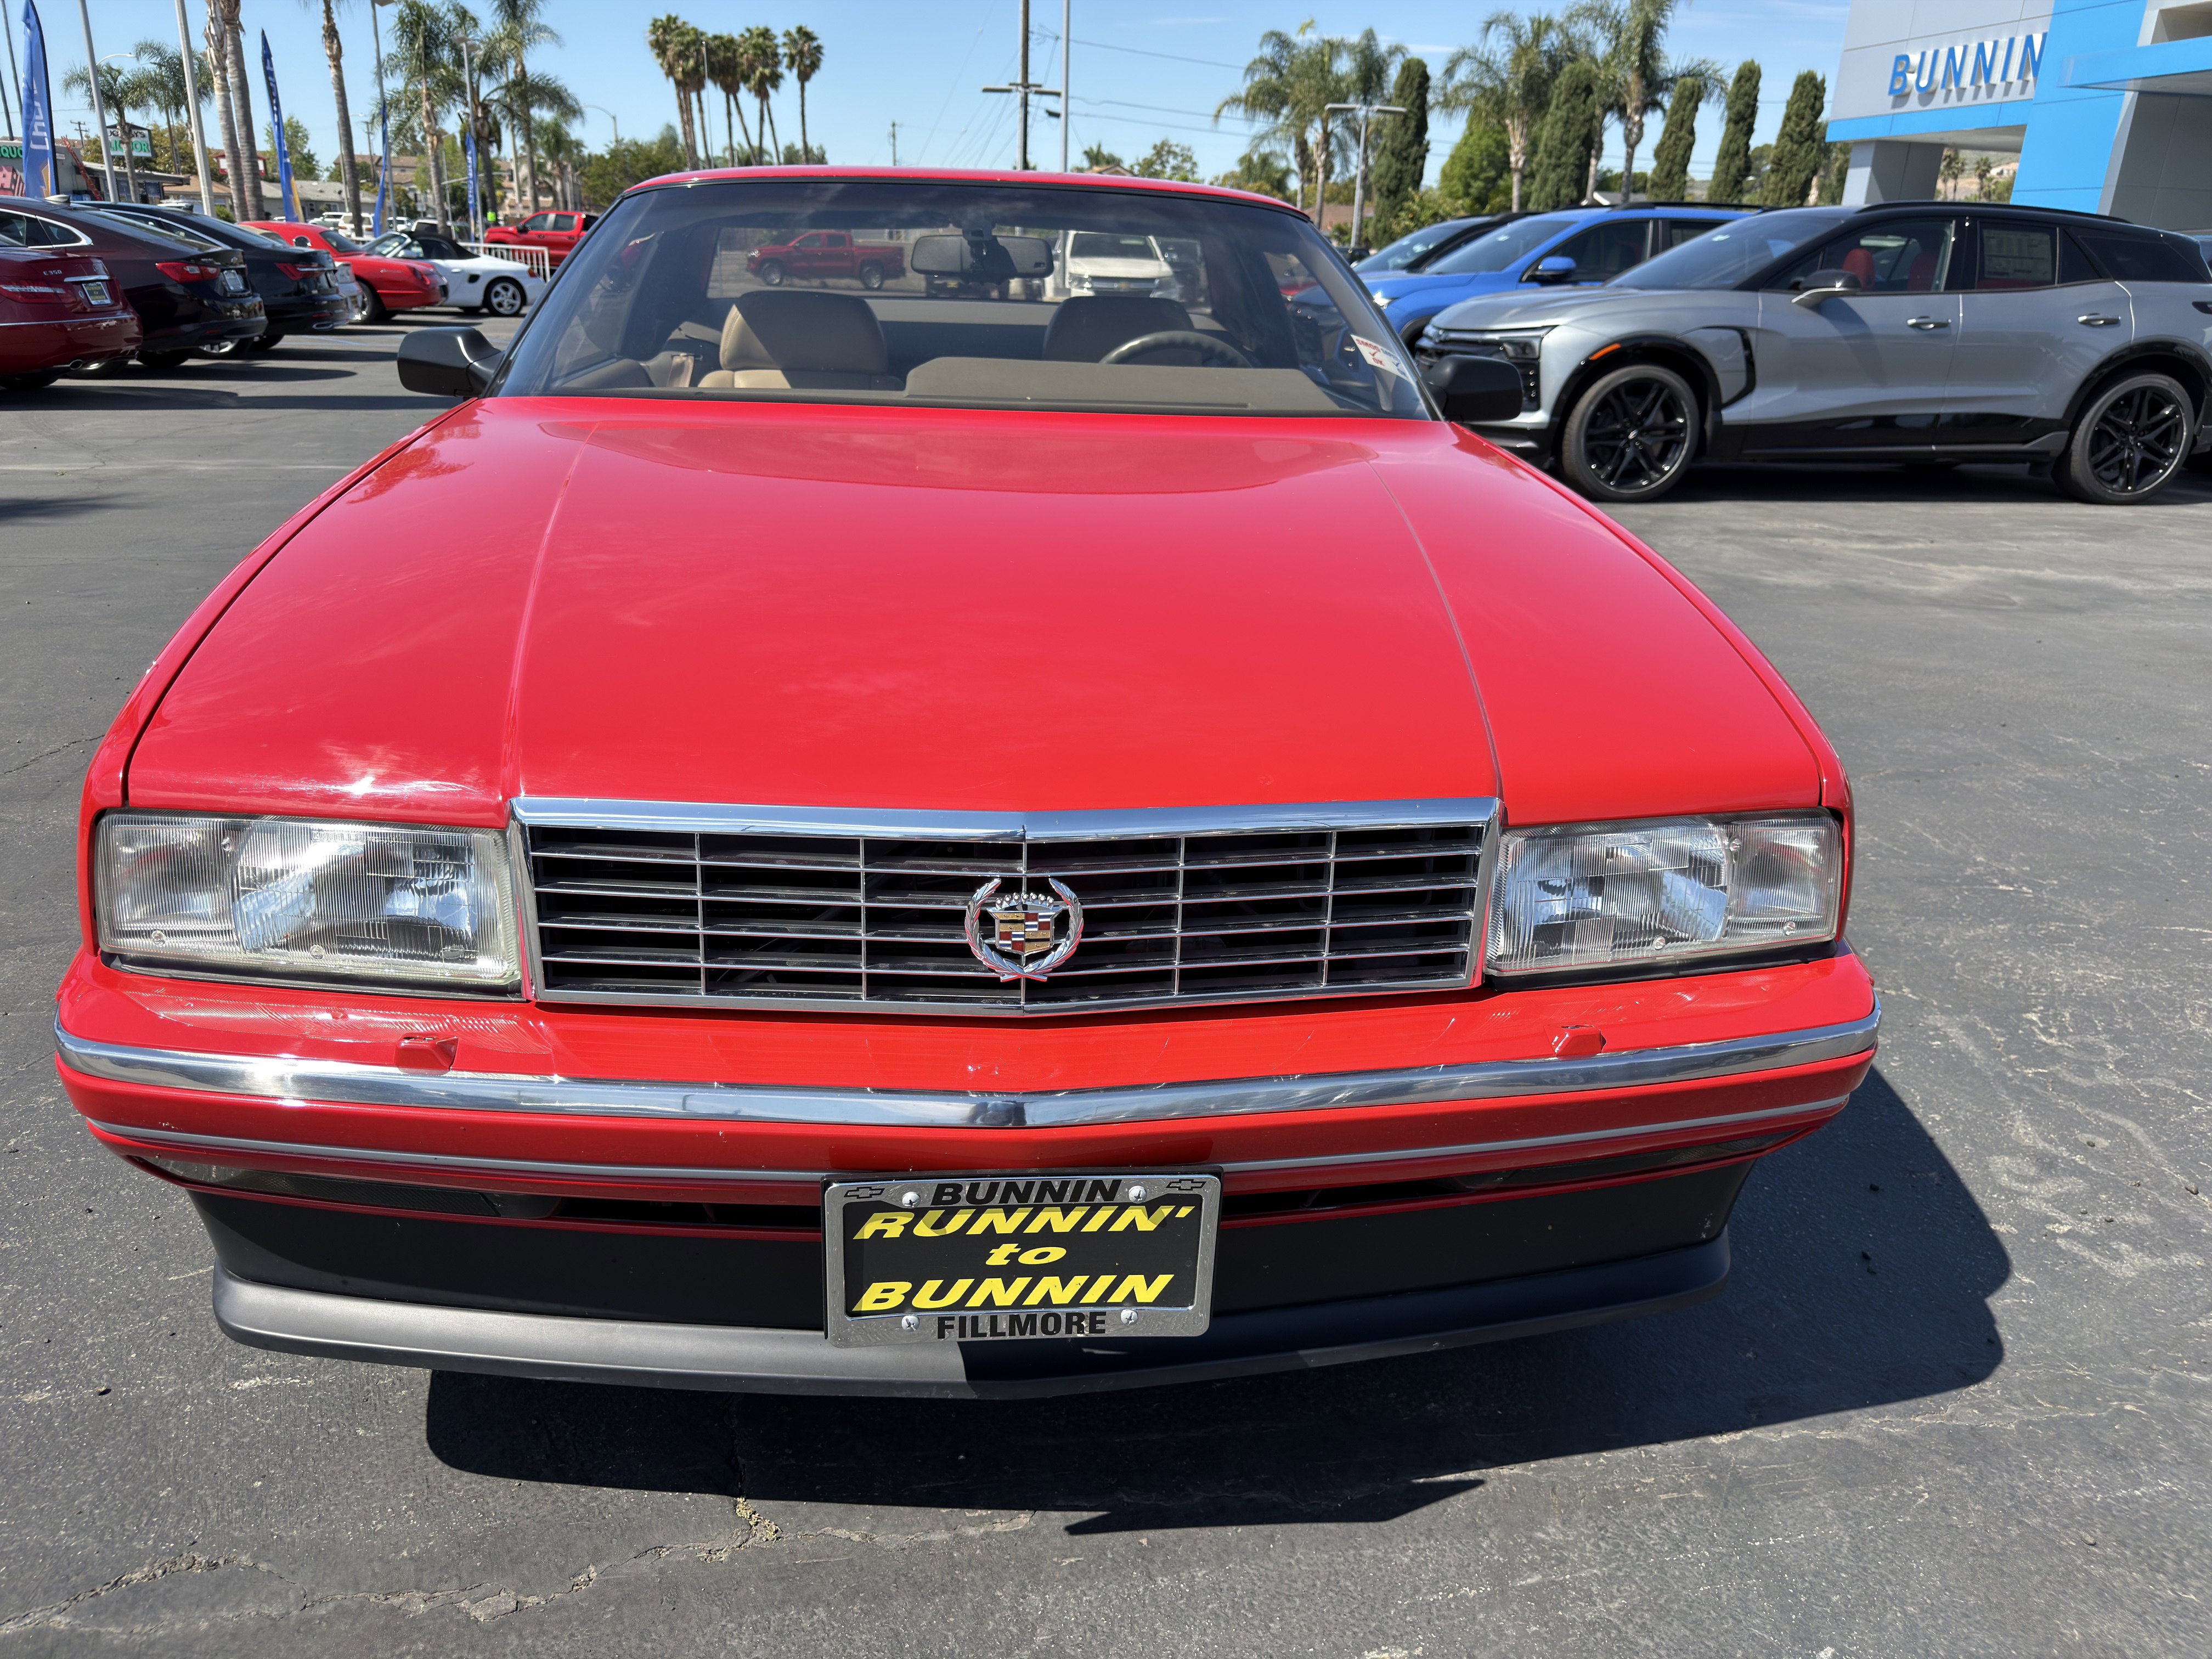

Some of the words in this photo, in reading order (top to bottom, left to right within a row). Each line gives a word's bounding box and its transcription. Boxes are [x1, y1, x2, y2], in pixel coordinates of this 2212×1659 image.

[1888, 32, 2048, 96] BUNNIN
[930, 1180, 1122, 1206] BUNNIN
[853, 1205, 1195, 1239] RUNNIN'
[985, 1243, 1067, 1266] to
[852, 1274, 1175, 1311] BUNNIN
[938, 1311, 1107, 1339] FILLMORE
